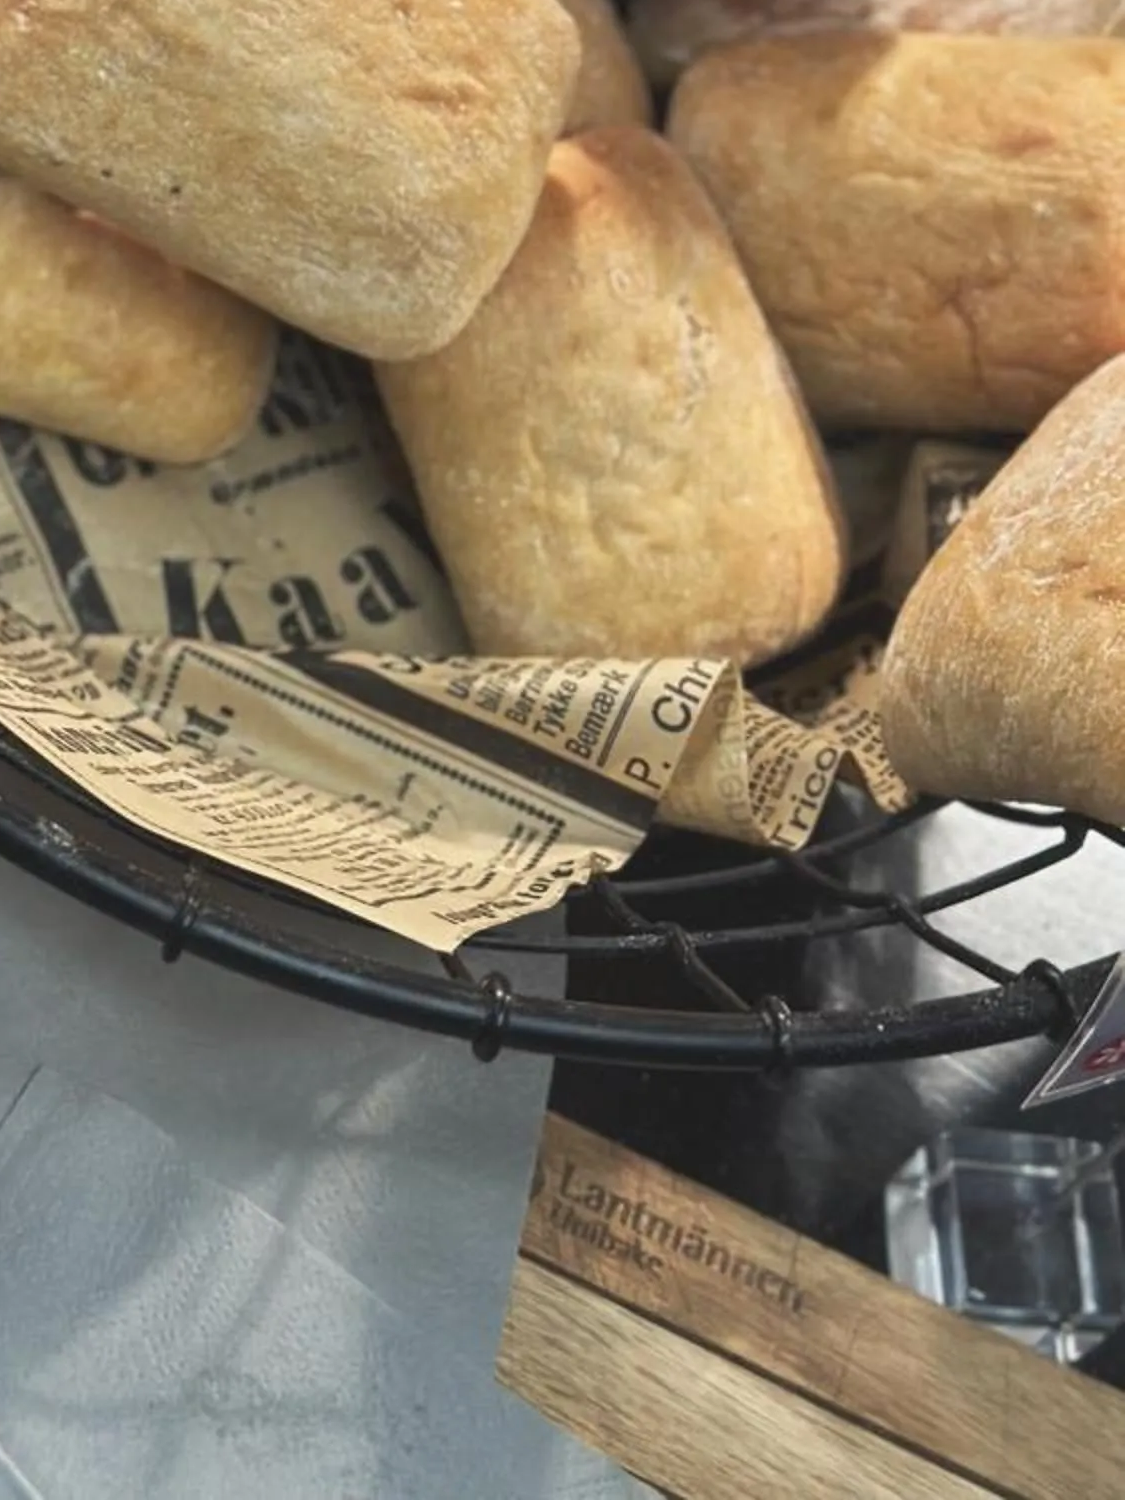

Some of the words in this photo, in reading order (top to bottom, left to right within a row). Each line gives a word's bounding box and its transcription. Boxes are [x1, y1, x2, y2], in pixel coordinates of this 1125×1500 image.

[565, 669, 630, 760] Bemærk
[624, 756, 672, 790] P.
[651, 659, 721, 734] Chr
[557, 1160, 809, 1319] Lantmännen
